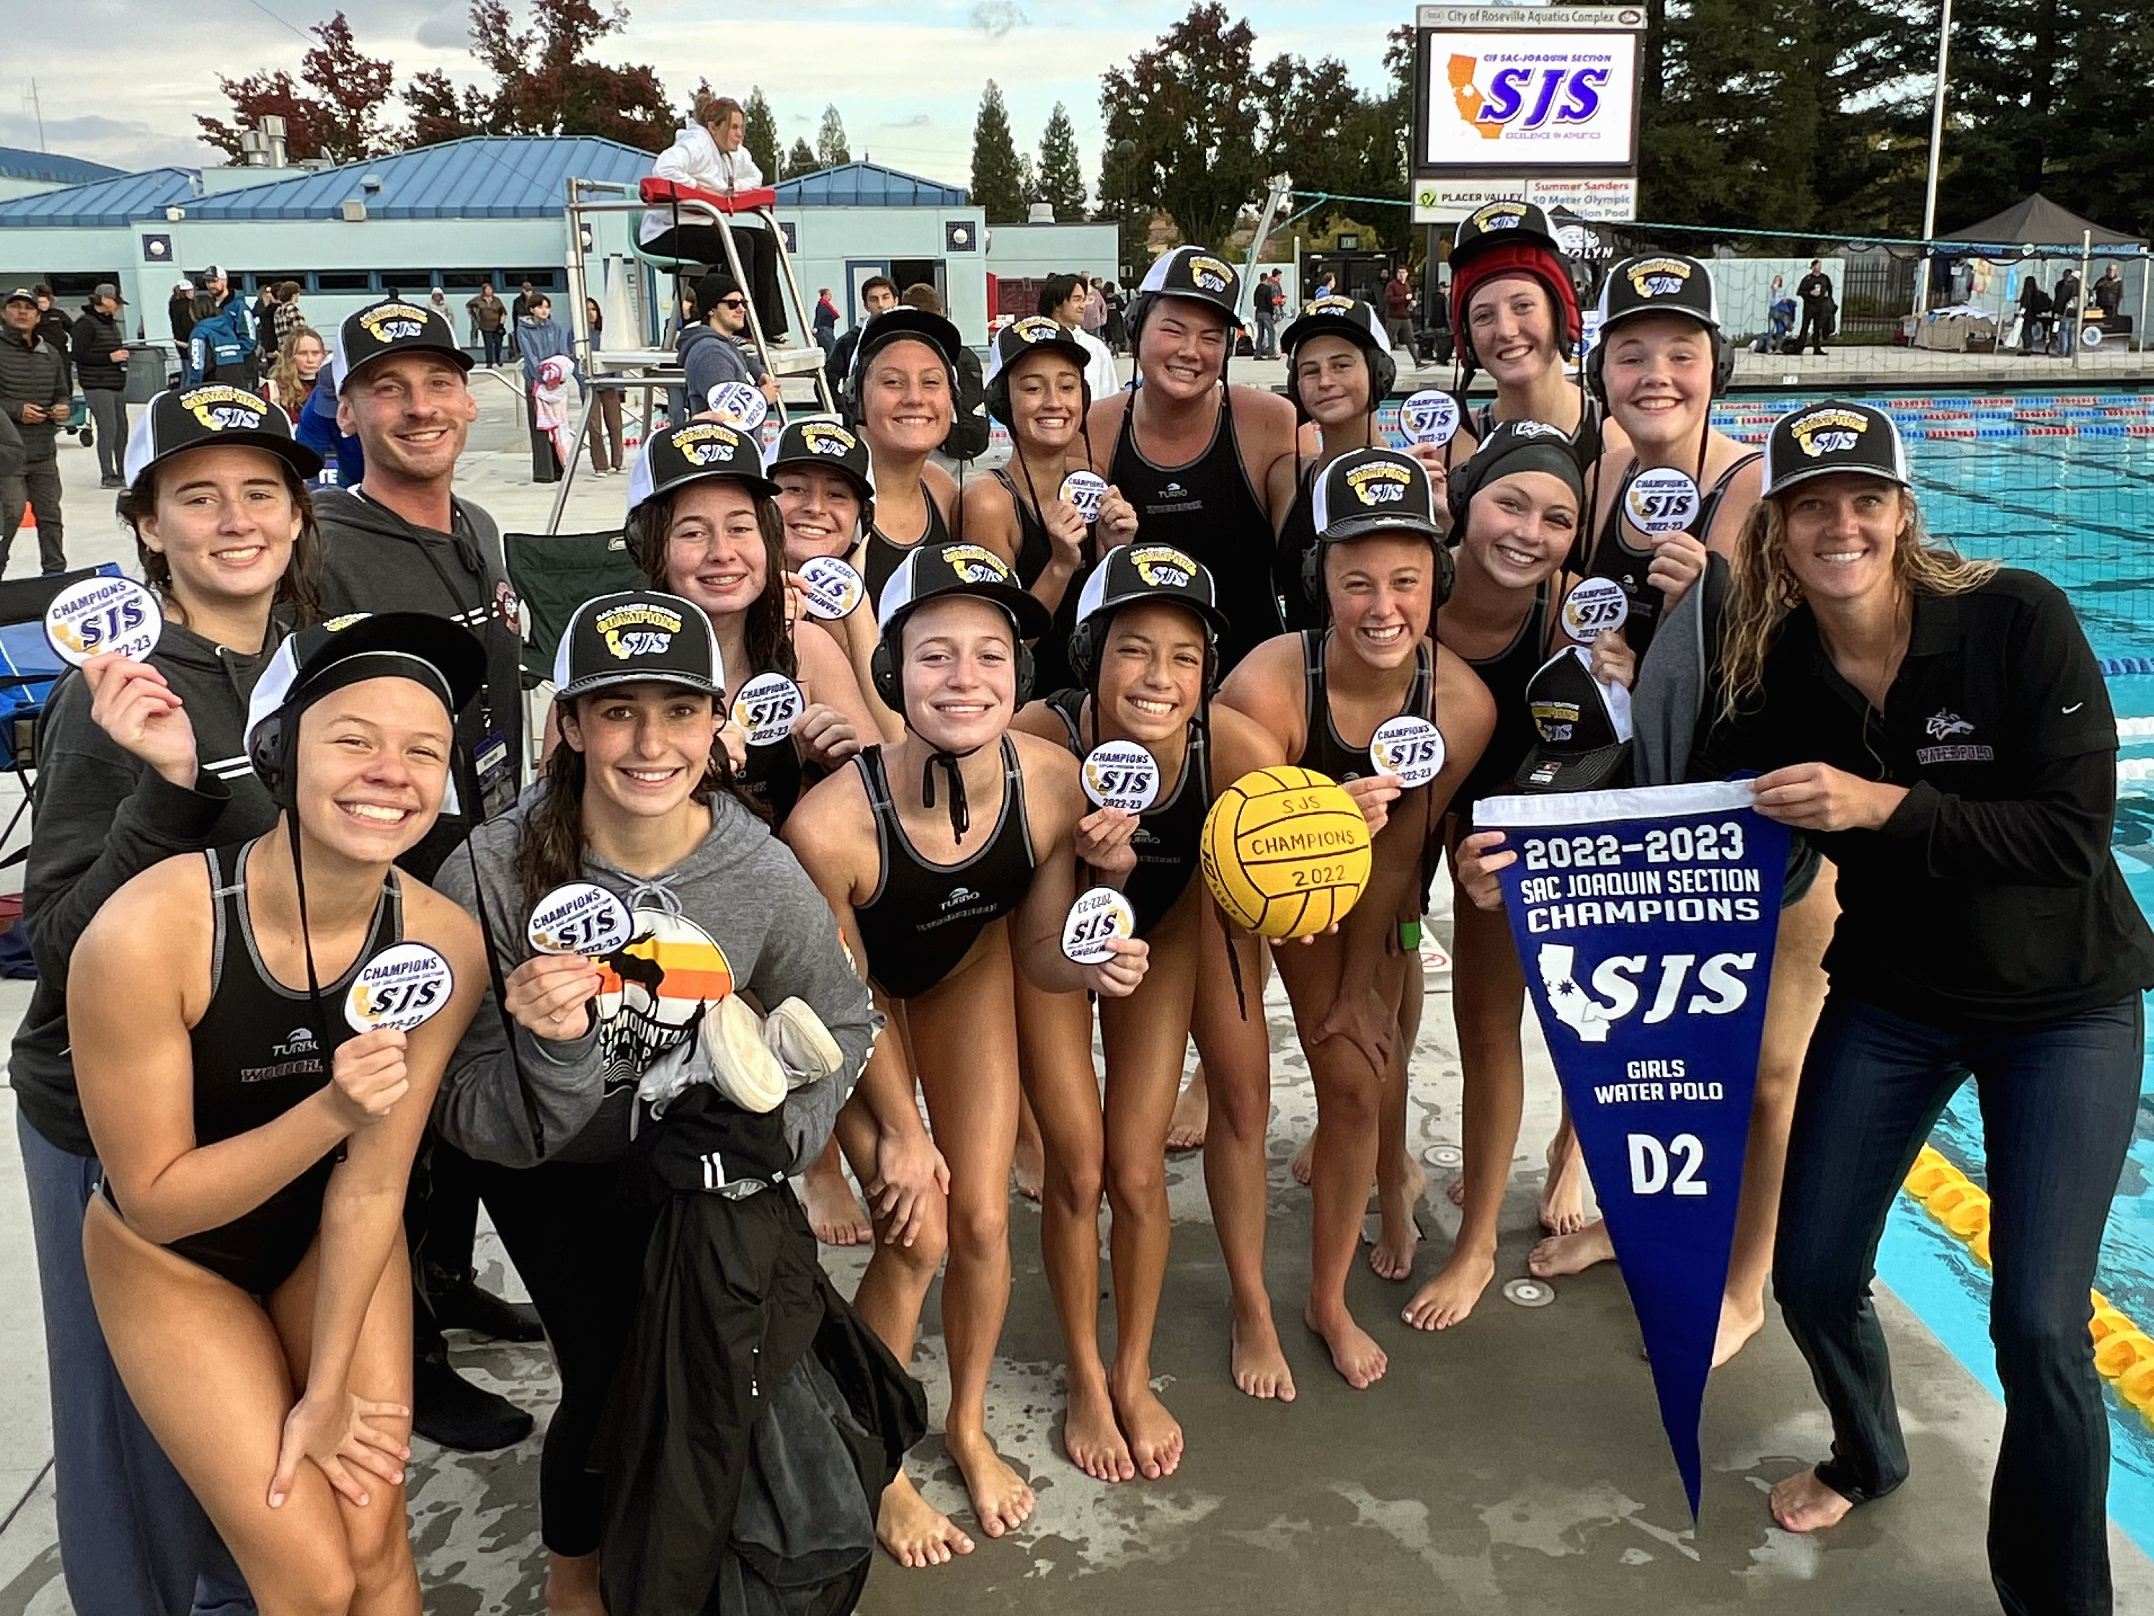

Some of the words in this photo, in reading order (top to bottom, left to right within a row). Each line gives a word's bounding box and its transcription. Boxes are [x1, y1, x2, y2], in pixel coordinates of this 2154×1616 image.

[1447, 10, 1467, 24] City
[1469, 10, 1480, 22] of
[1481, 10, 1525, 22] Roseville
[1527, 10, 1570, 24] Aquatics
[1571, 10, 1615, 24] Complex
[1571, 54, 1612, 62] SECTION
[1476, 67, 1612, 130] SJS
[1535, 182, 1582, 191] Summer
[1584, 181, 1629, 191] Sanders
[1442, 193, 1482, 202] PLACER
[1484, 193, 1523, 203] VALLEY
[1533, 195, 1545, 205] 50
[1549, 195, 1581, 204] Meter
[1584, 194, 1630, 206] Olympic
[1604, 208, 1630, 218] Pool
[1567, 247, 1614, 259] OLYN
[1413, 409, 1455, 431] SJS
[1641, 496, 1694, 518] SJS
[52, 581, 127, 620] CHAMPIONS
[80, 595, 146, 651] SJS
[1577, 601, 1622, 624] SJS
[621, 632, 672, 655] SJS
[748, 697, 796, 726] SJS
[1377, 725, 1430, 740] CHAMPIONS
[1092, 752, 1149, 764] CHAMPIONS
[1389, 740, 1437, 766] SJS
[1098, 771, 1153, 795] SJS
[1102, 798, 1142, 809] 2022-23
[1282, 795, 1322, 813] SJS
[1251, 829, 1355, 856] CHAMPIONS
[1523, 822, 1744, 870] 2022-2023
[1292, 864, 1346, 887] 2022
[1520, 875, 1561, 904] SAC
[1566, 870, 1661, 898] JOAQUIN
[1667, 868, 1760, 894] SECTION
[532, 888, 601, 929] CHAMPIONS
[1527, 898, 1760, 933] CHAMPIONS
[558, 904, 618, 949] SJS
[1067, 912, 1119, 945] SJS
[363, 957, 437, 981] CHAMPIONS
[367, 980, 443, 1016] SJS
[1580, 952, 1757, 1025] SJS
[1626, 1059, 1685, 1078] GIRLS
[1594, 1082, 1665, 1104] WATER
[1670, 1082, 1723, 1100] POLO
[1627, 1132, 1708, 1197] D2
